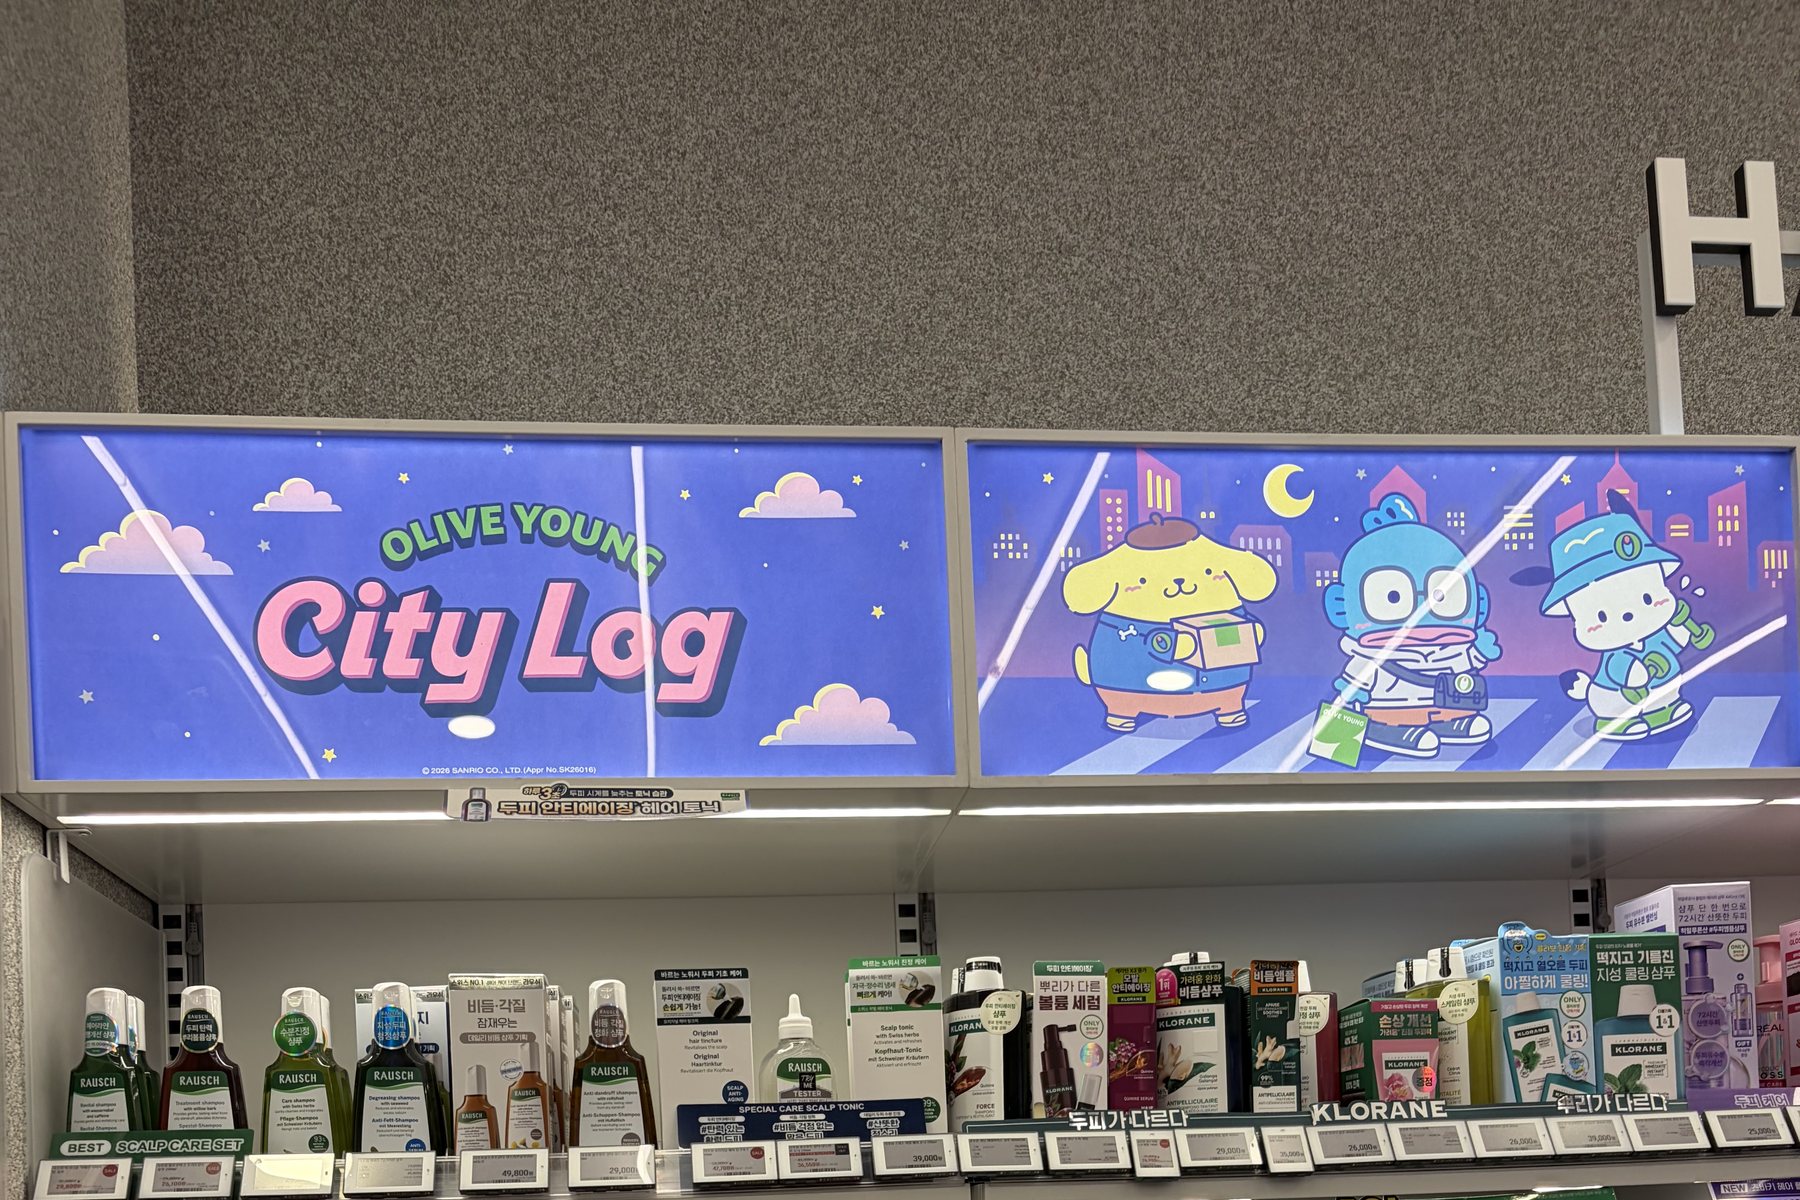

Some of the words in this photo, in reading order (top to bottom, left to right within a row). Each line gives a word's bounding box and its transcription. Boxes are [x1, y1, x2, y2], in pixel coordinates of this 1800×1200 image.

[1646, 157, 1800, 317] H
[381, 504, 504, 564] OLIVE
[512, 503, 666, 580] YOUNG
[256, 580, 506, 704] City
[522, 582, 735, 705] Log
[499, 802, 535, 815] 두피
[540, 801, 634, 815] 안티에이징
[641, 801, 679, 814] 헤어
[682, 800, 719, 813] 토닉
[1597, 951, 1632, 965] 떡지고
[1638, 949, 1674, 964] 기름진
[1597, 967, 1621, 981] 지성
[1625, 966, 1648, 980] 쿨링
[1651, 965, 1675, 980] 샴푸
[1039, 981, 1073, 994] 뿌리가
[1077, 980, 1101, 993] 다른
[1504, 974, 1556, 990] 아찔하게
[1559, 974, 1588, 989] 쿨링!
[1179, 984, 1223, 998] 비듬샴푸
[1039, 995, 1068, 1011] 볼륨
[1071, 994, 1101, 1011] 세럼
[477, 1017, 518, 1029] 잠재우는
[1159, 1016, 1211, 1028] KLORANE
[1515, 1027, 1549, 1037] KLORANE
[1615, 1044, 1663, 1054] KLORANE
[591, 1064, 629, 1078] RAUSCH
[788, 1062, 823, 1073] RAUSCH
[80, 1077, 116, 1088] RAUSCH
[179, 1074, 220, 1086] RAUSCH
[279, 1072, 317, 1084] RAUSCH
[373, 1069, 414, 1082] RAUSCH
[739, 1105, 775, 1114] SPECIAL
[777, 1104, 801, 1113] CARE
[804, 1103, 832, 1112] SCALP
[834, 1102, 864, 1111] TONIC
[1614, 1094, 1666, 1112] 다르다
[1312, 1100, 1447, 1122] KLORANE
[1069, 1112, 1125, 1129] 두피가
[1129, 1110, 1188, 1128] 다르다
[67, 1141, 104, 1154] BEST
[116, 1139, 167, 1153] SCALP
[170, 1138, 209, 1152] CARE
[212, 1137, 244, 1150] SET
